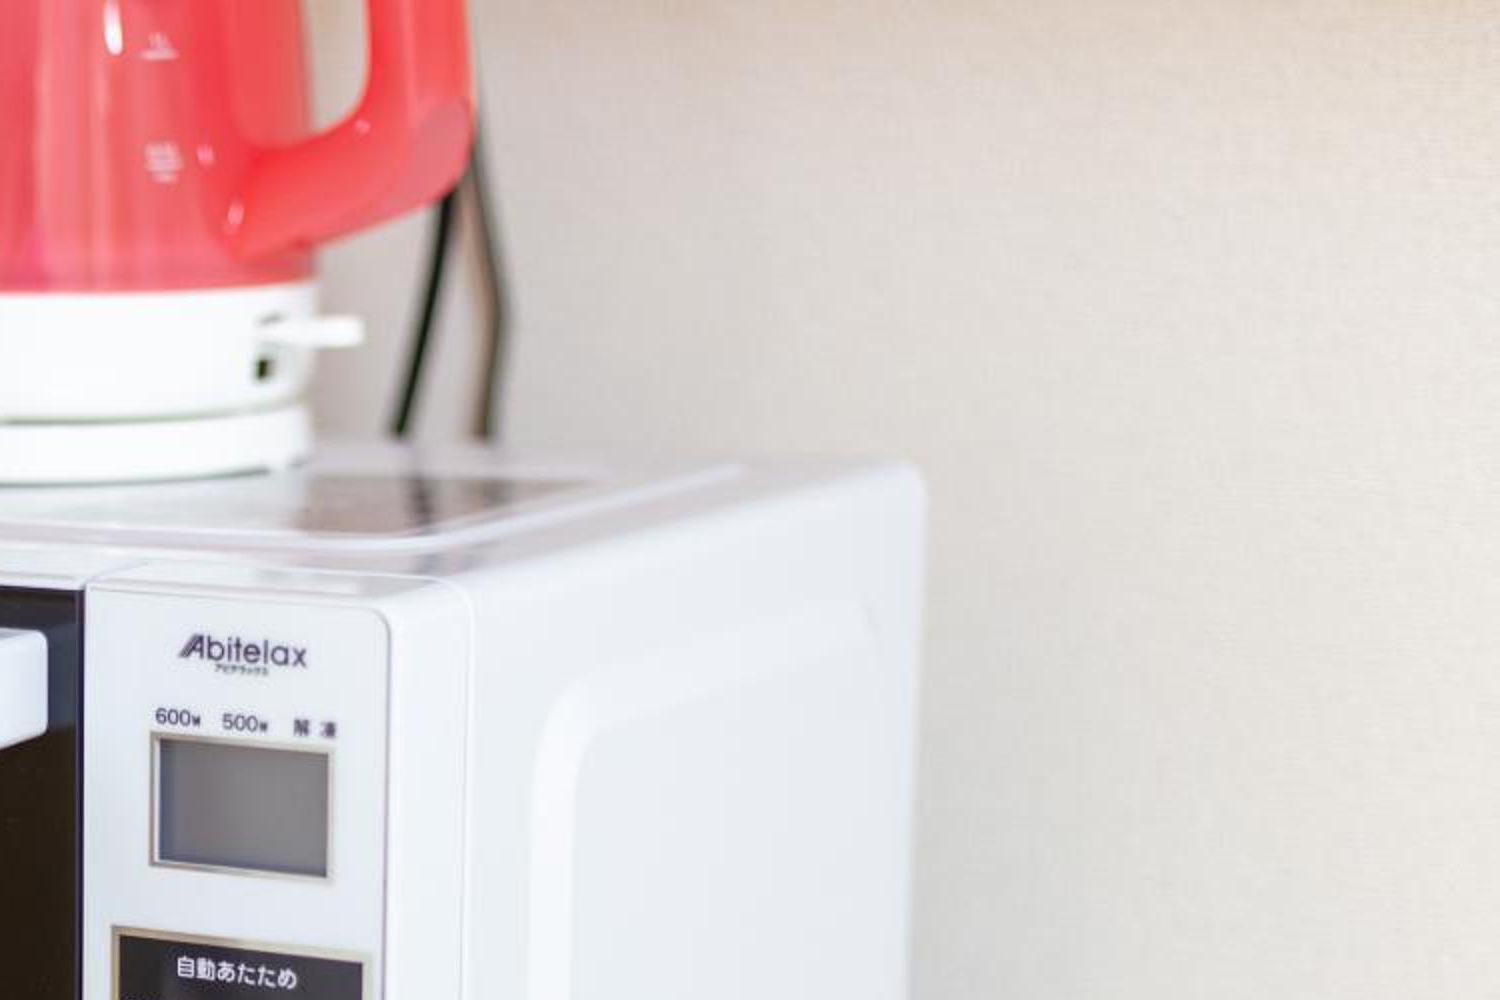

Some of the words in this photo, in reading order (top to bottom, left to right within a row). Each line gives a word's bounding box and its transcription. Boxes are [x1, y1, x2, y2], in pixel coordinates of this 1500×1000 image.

[178, 634, 307, 668] Abitelax
[176, 955, 298, 990] 自動あたため
